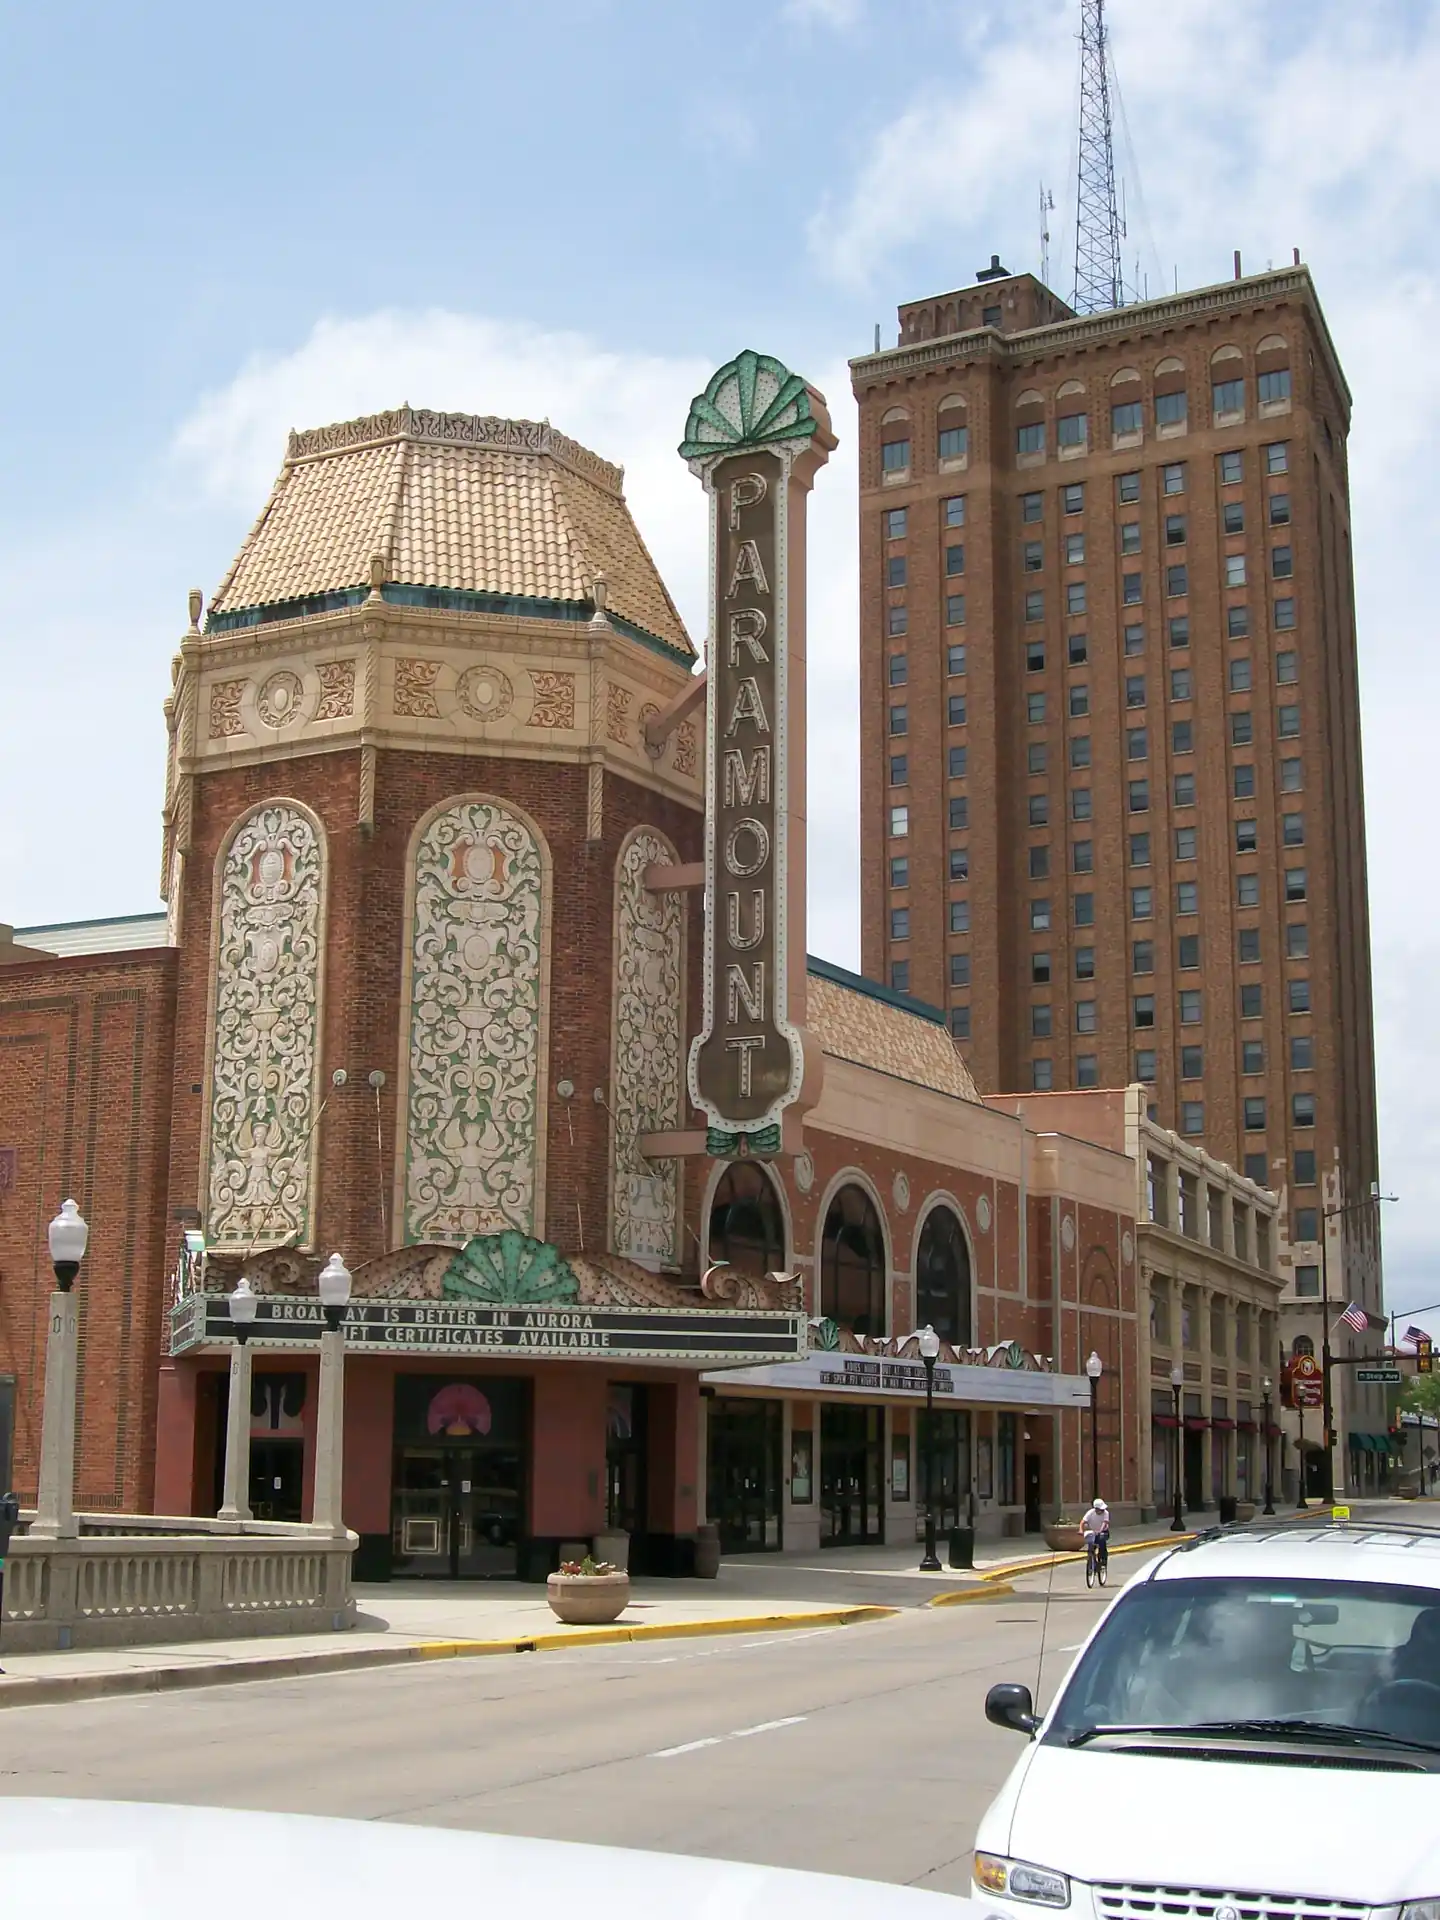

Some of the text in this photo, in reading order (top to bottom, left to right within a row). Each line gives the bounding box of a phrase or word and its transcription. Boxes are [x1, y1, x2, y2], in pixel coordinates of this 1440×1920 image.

[722, 472, 770, 1098] PARAMOUNT
[383, 1308, 400, 1322] IS
[415, 1309, 477, 1325] BETTER
[492, 1311, 510, 1326] IN
[525, 1313, 594, 1329] AURORA
[337, 1324, 610, 1347] IFT CERTIFICATES AVAILABLE
